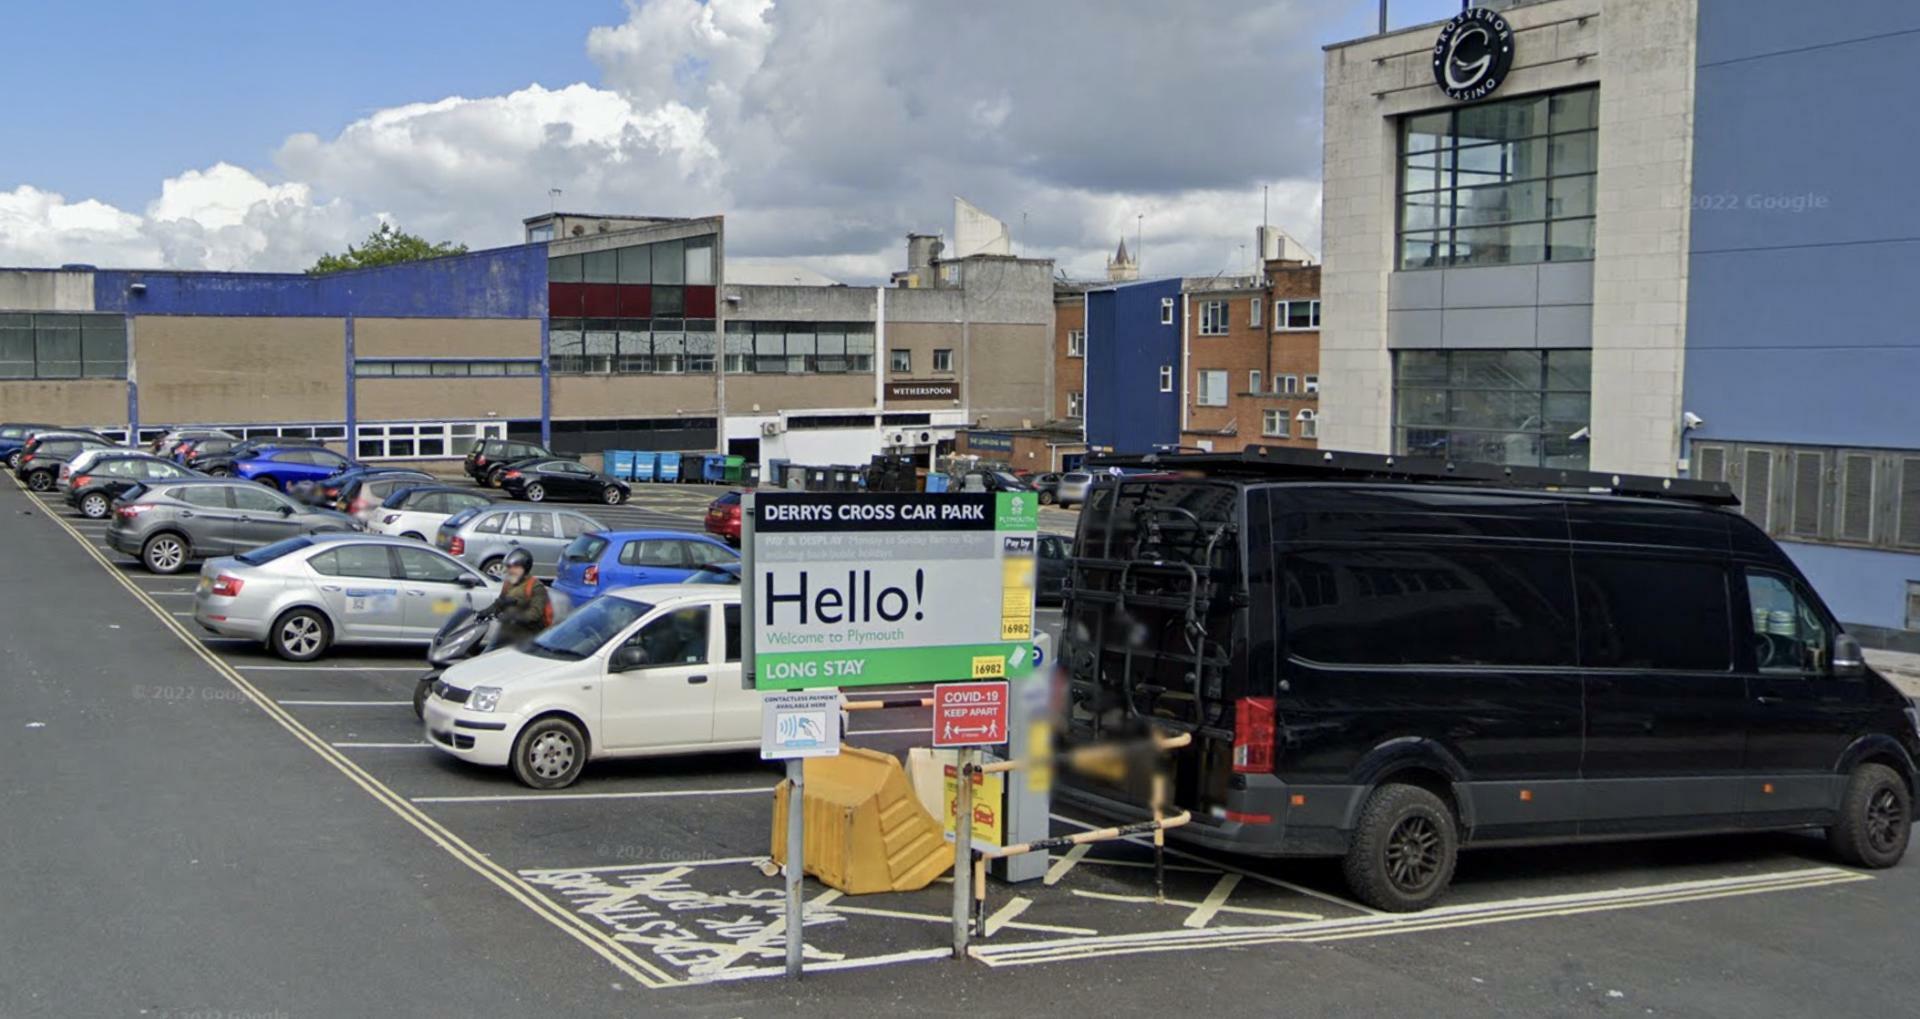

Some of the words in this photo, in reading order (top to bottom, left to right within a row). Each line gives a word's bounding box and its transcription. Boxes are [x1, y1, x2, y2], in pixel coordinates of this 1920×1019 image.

[1434, 8, 1508, 54] GROSVENOR
[1446, 78, 1495, 100] CASINO
[893, 386, 952, 396] WETHERSPOON
[765, 504, 833, 520] DERRYS
[838, 504, 895, 520] CROSS
[900, 504, 937, 520] CAR
[941, 504, 984, 520] PARK
[766, 535, 784, 546] PAY
[799, 535, 842, 546] DISPLAY
[1006, 538, 1019, 549] Pay
[1020, 538, 1031, 551] by
[766, 568, 924, 626] Hello!
[766, 630, 825, 645] Welcome
[829, 632, 843, 643] to
[847, 627, 904, 645] Plymouth
[1003, 624, 1030, 635] 16982
[766, 660, 817, 680] LONG
[823, 659, 865, 677] STAY
[975, 663, 1002, 675] 16982
[764, 694, 808, 703] CONTACTLESS
[944, 690, 999, 703] COVID-19
[944, 708, 969, 718] KEEP
[970, 707, 998, 717] APART
